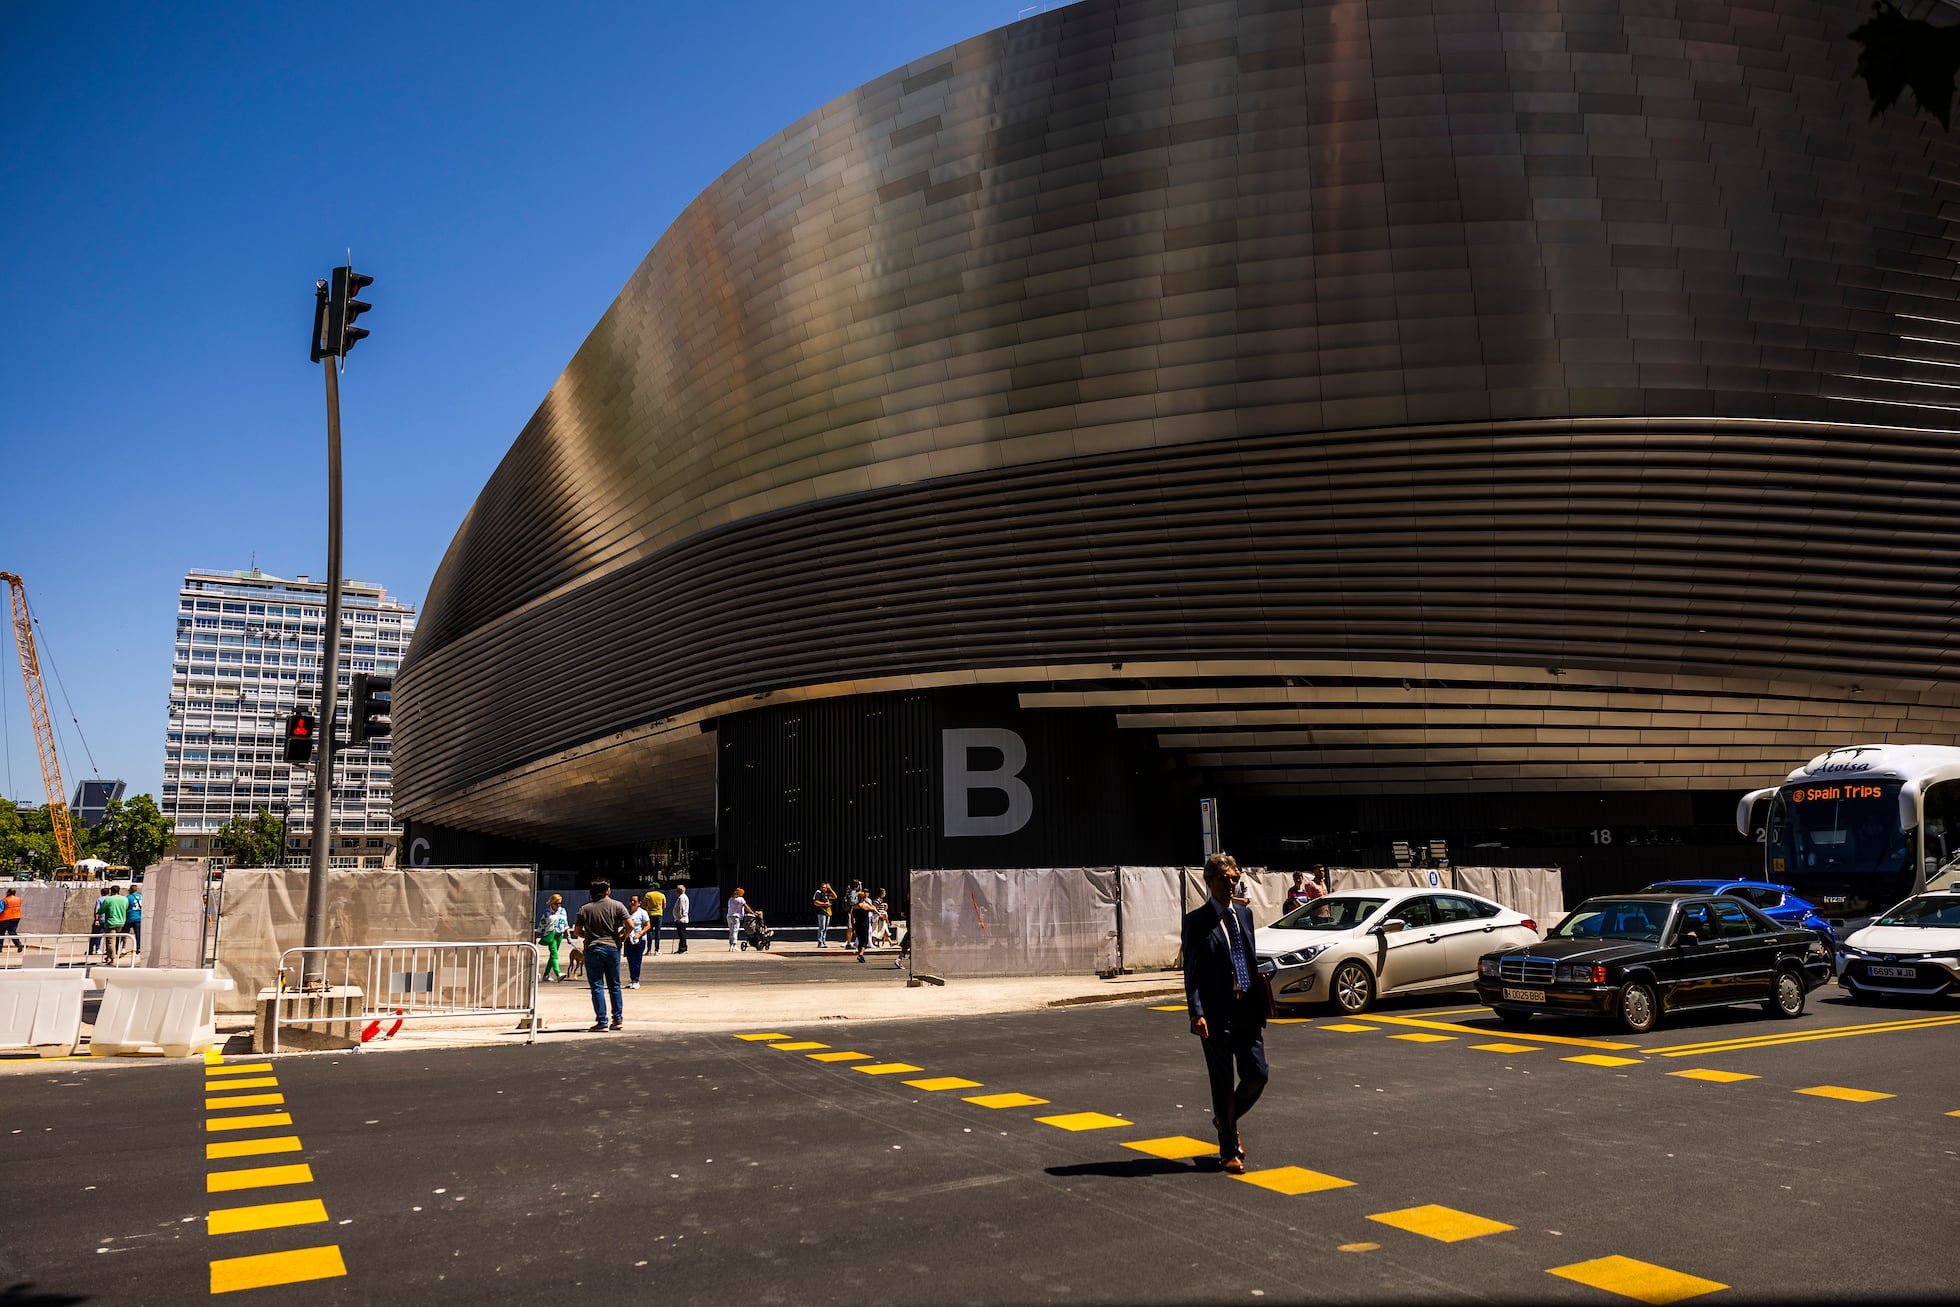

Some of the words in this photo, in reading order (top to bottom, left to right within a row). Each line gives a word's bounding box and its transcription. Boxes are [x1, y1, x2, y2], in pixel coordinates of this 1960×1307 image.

[943, 728, 1033, 837] B
[1807, 787, 1840, 801] Spain
[1844, 785, 1881, 798] Trips
[1590, 829, 1612, 844] 18
[410, 837, 430, 868] C
[1873, 967, 1894, 976] 6695
[1512, 990, 1529, 1000] 0025
